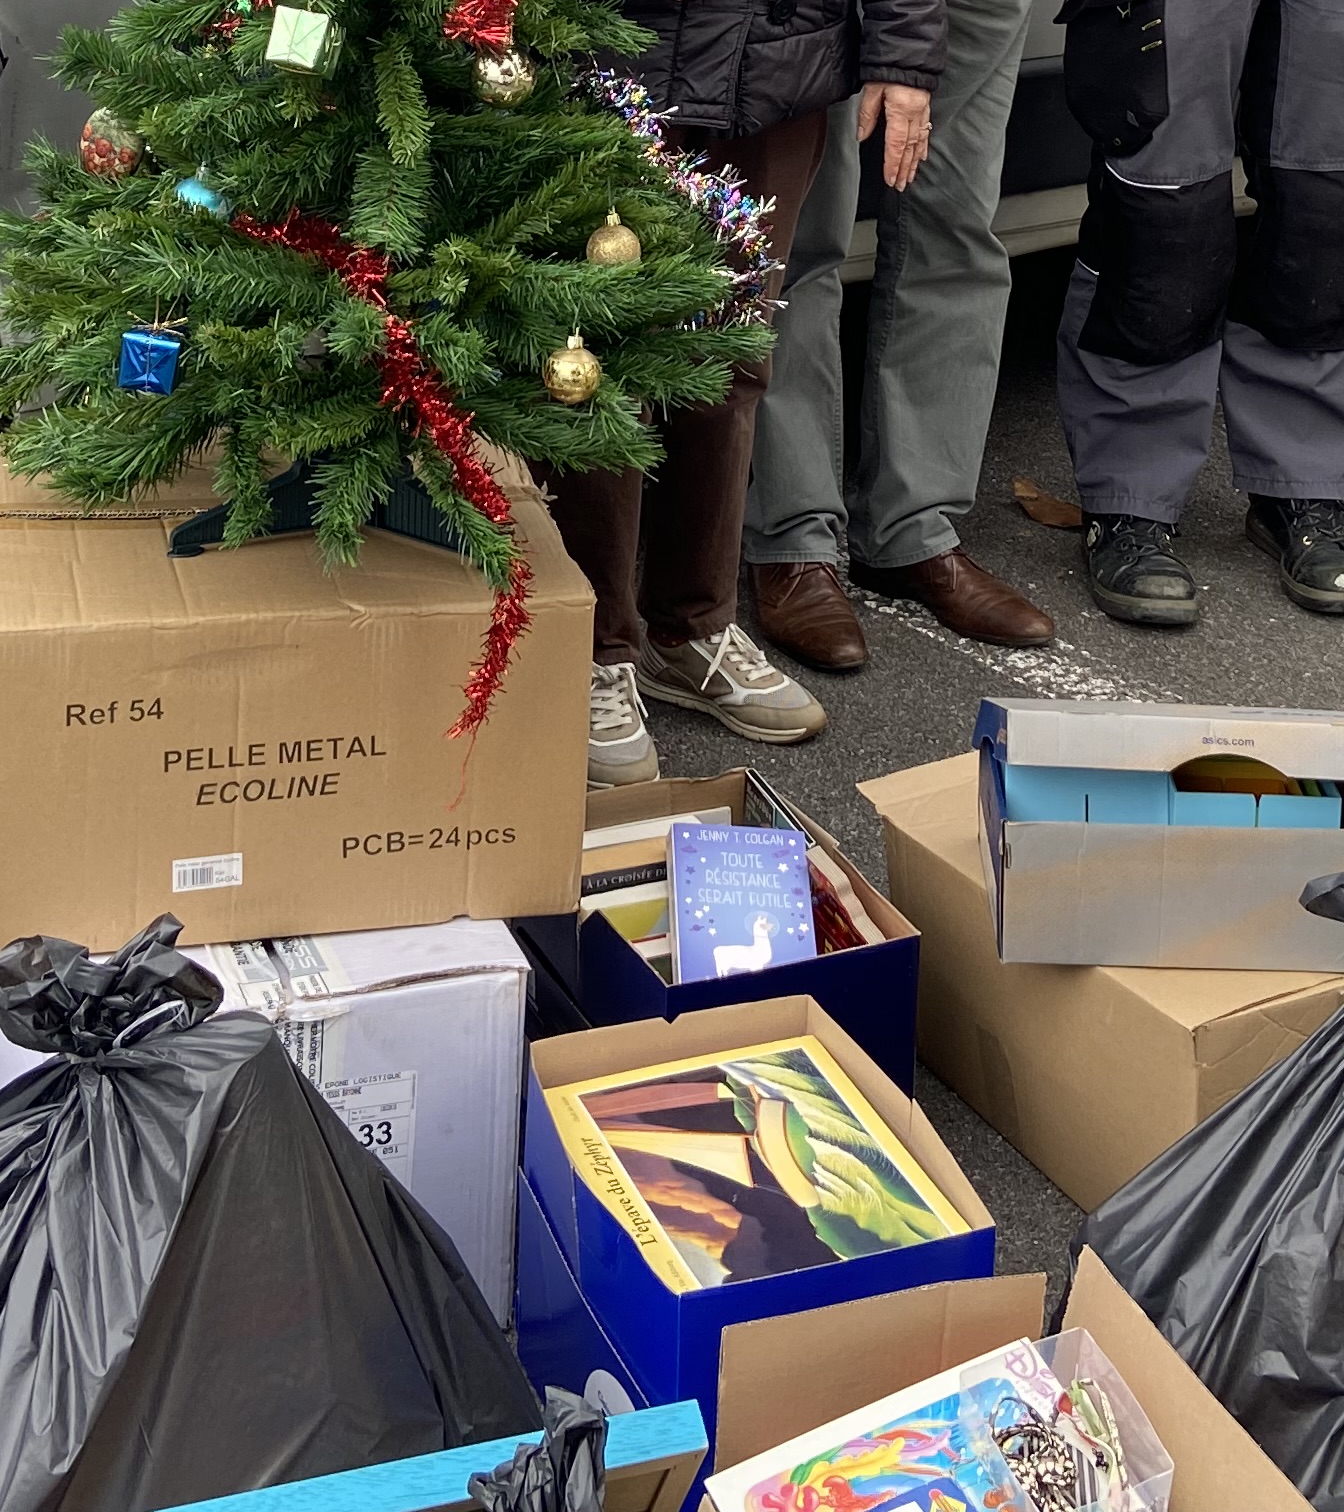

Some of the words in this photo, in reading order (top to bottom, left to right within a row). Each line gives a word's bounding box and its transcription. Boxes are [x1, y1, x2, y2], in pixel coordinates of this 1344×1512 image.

[65, 700, 119, 727] Ref
[129, 697, 164, 723] 54
[1201, 736, 1255, 747] asics.com
[163, 742, 267, 773] PELLE
[278, 734, 388, 765] METAL
[195, 771, 341, 806] ECOLINE
[697, 829, 730, 843] JENNY
[744, 832, 784, 847] COLGAN
[720, 851, 764, 869] TOUTE
[596, 877, 608, 888] LA
[611, 868, 654, 885] CROISÉE
[705, 867, 782, 889] RÉSISTANCE
[697, 887, 743, 906] SERAIT
[748, 891, 792, 909] FUTILE
[353, 1071, 402, 1085] LOGISTIQUE
[580, 1137, 614, 1176] Zéphyr
[606, 1178, 626, 1196] du
[619, 1197, 659, 1247] L'épave
